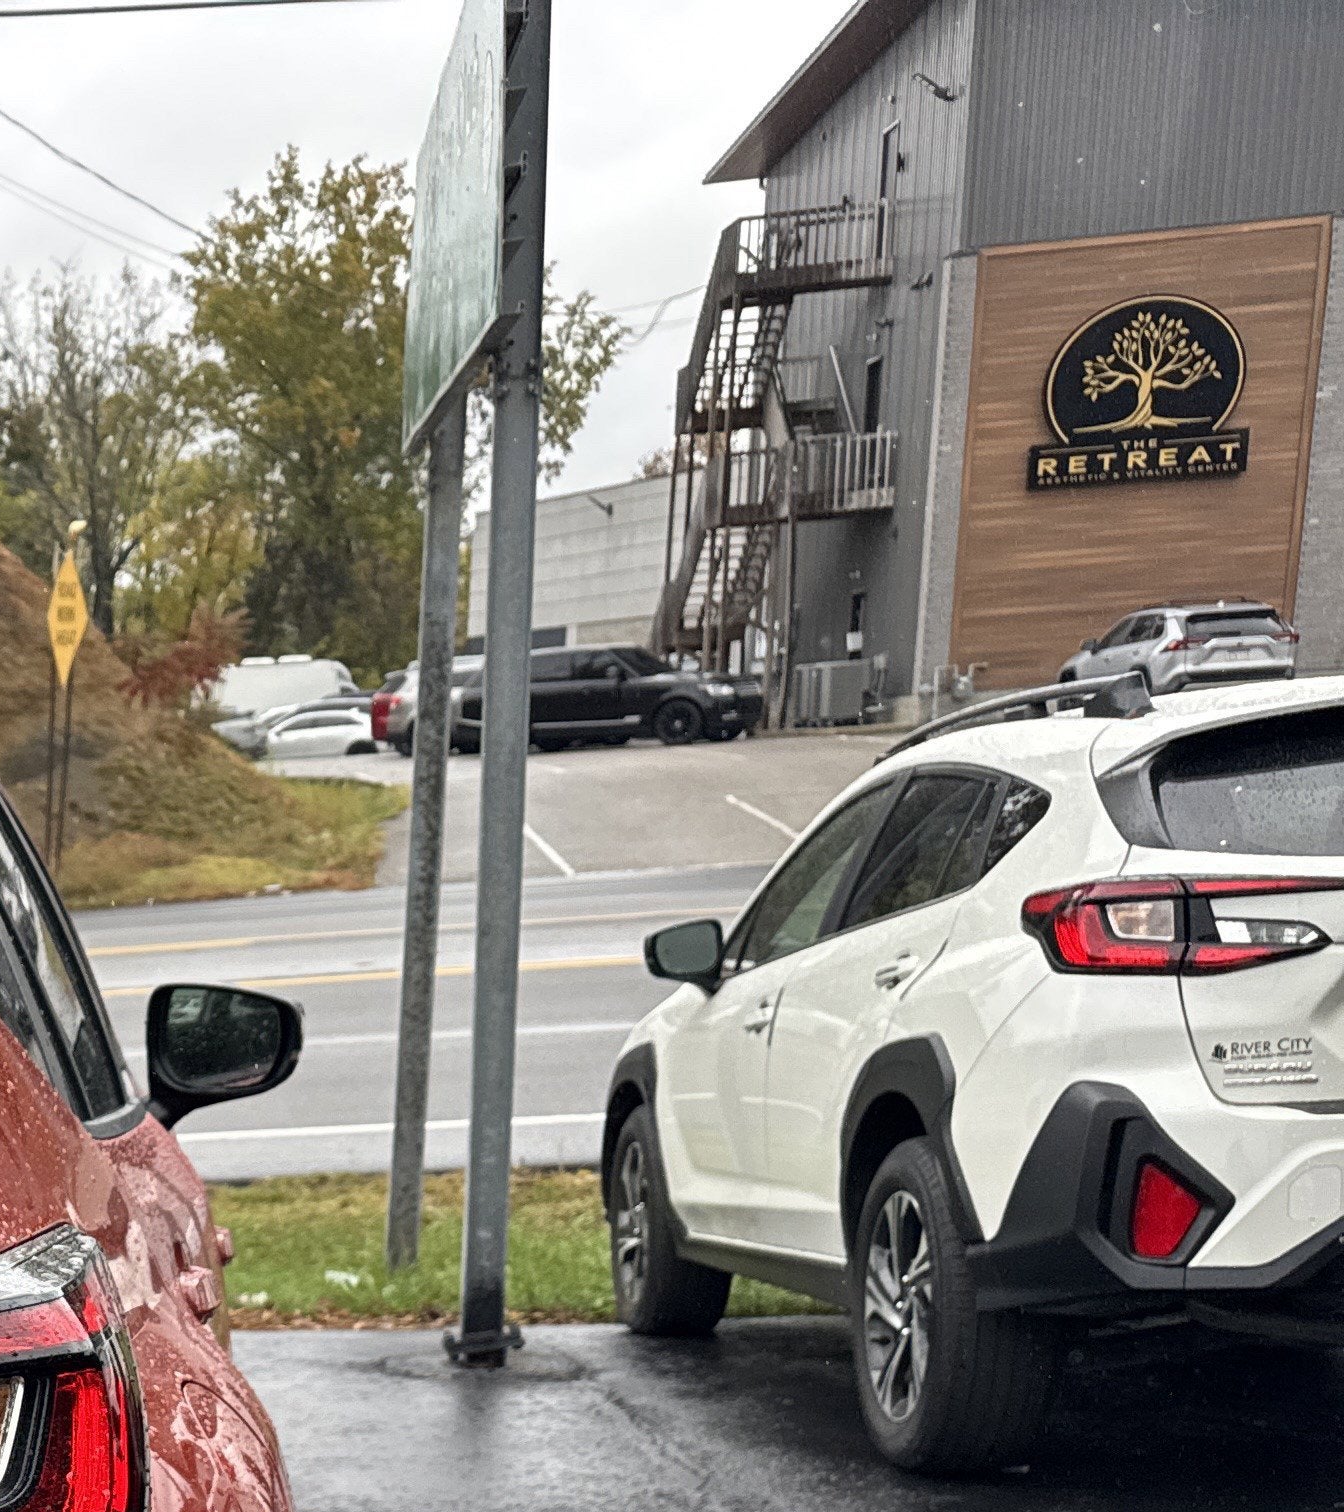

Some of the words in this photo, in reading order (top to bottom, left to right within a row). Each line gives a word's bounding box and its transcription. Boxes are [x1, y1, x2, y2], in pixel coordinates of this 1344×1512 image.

[1121, 437, 1158, 450] THE
[1037, 442, 1241, 477] RETREAT
[1230, 1040, 1271, 1055] RIVER
[1277, 1037, 1313, 1052] CITY
